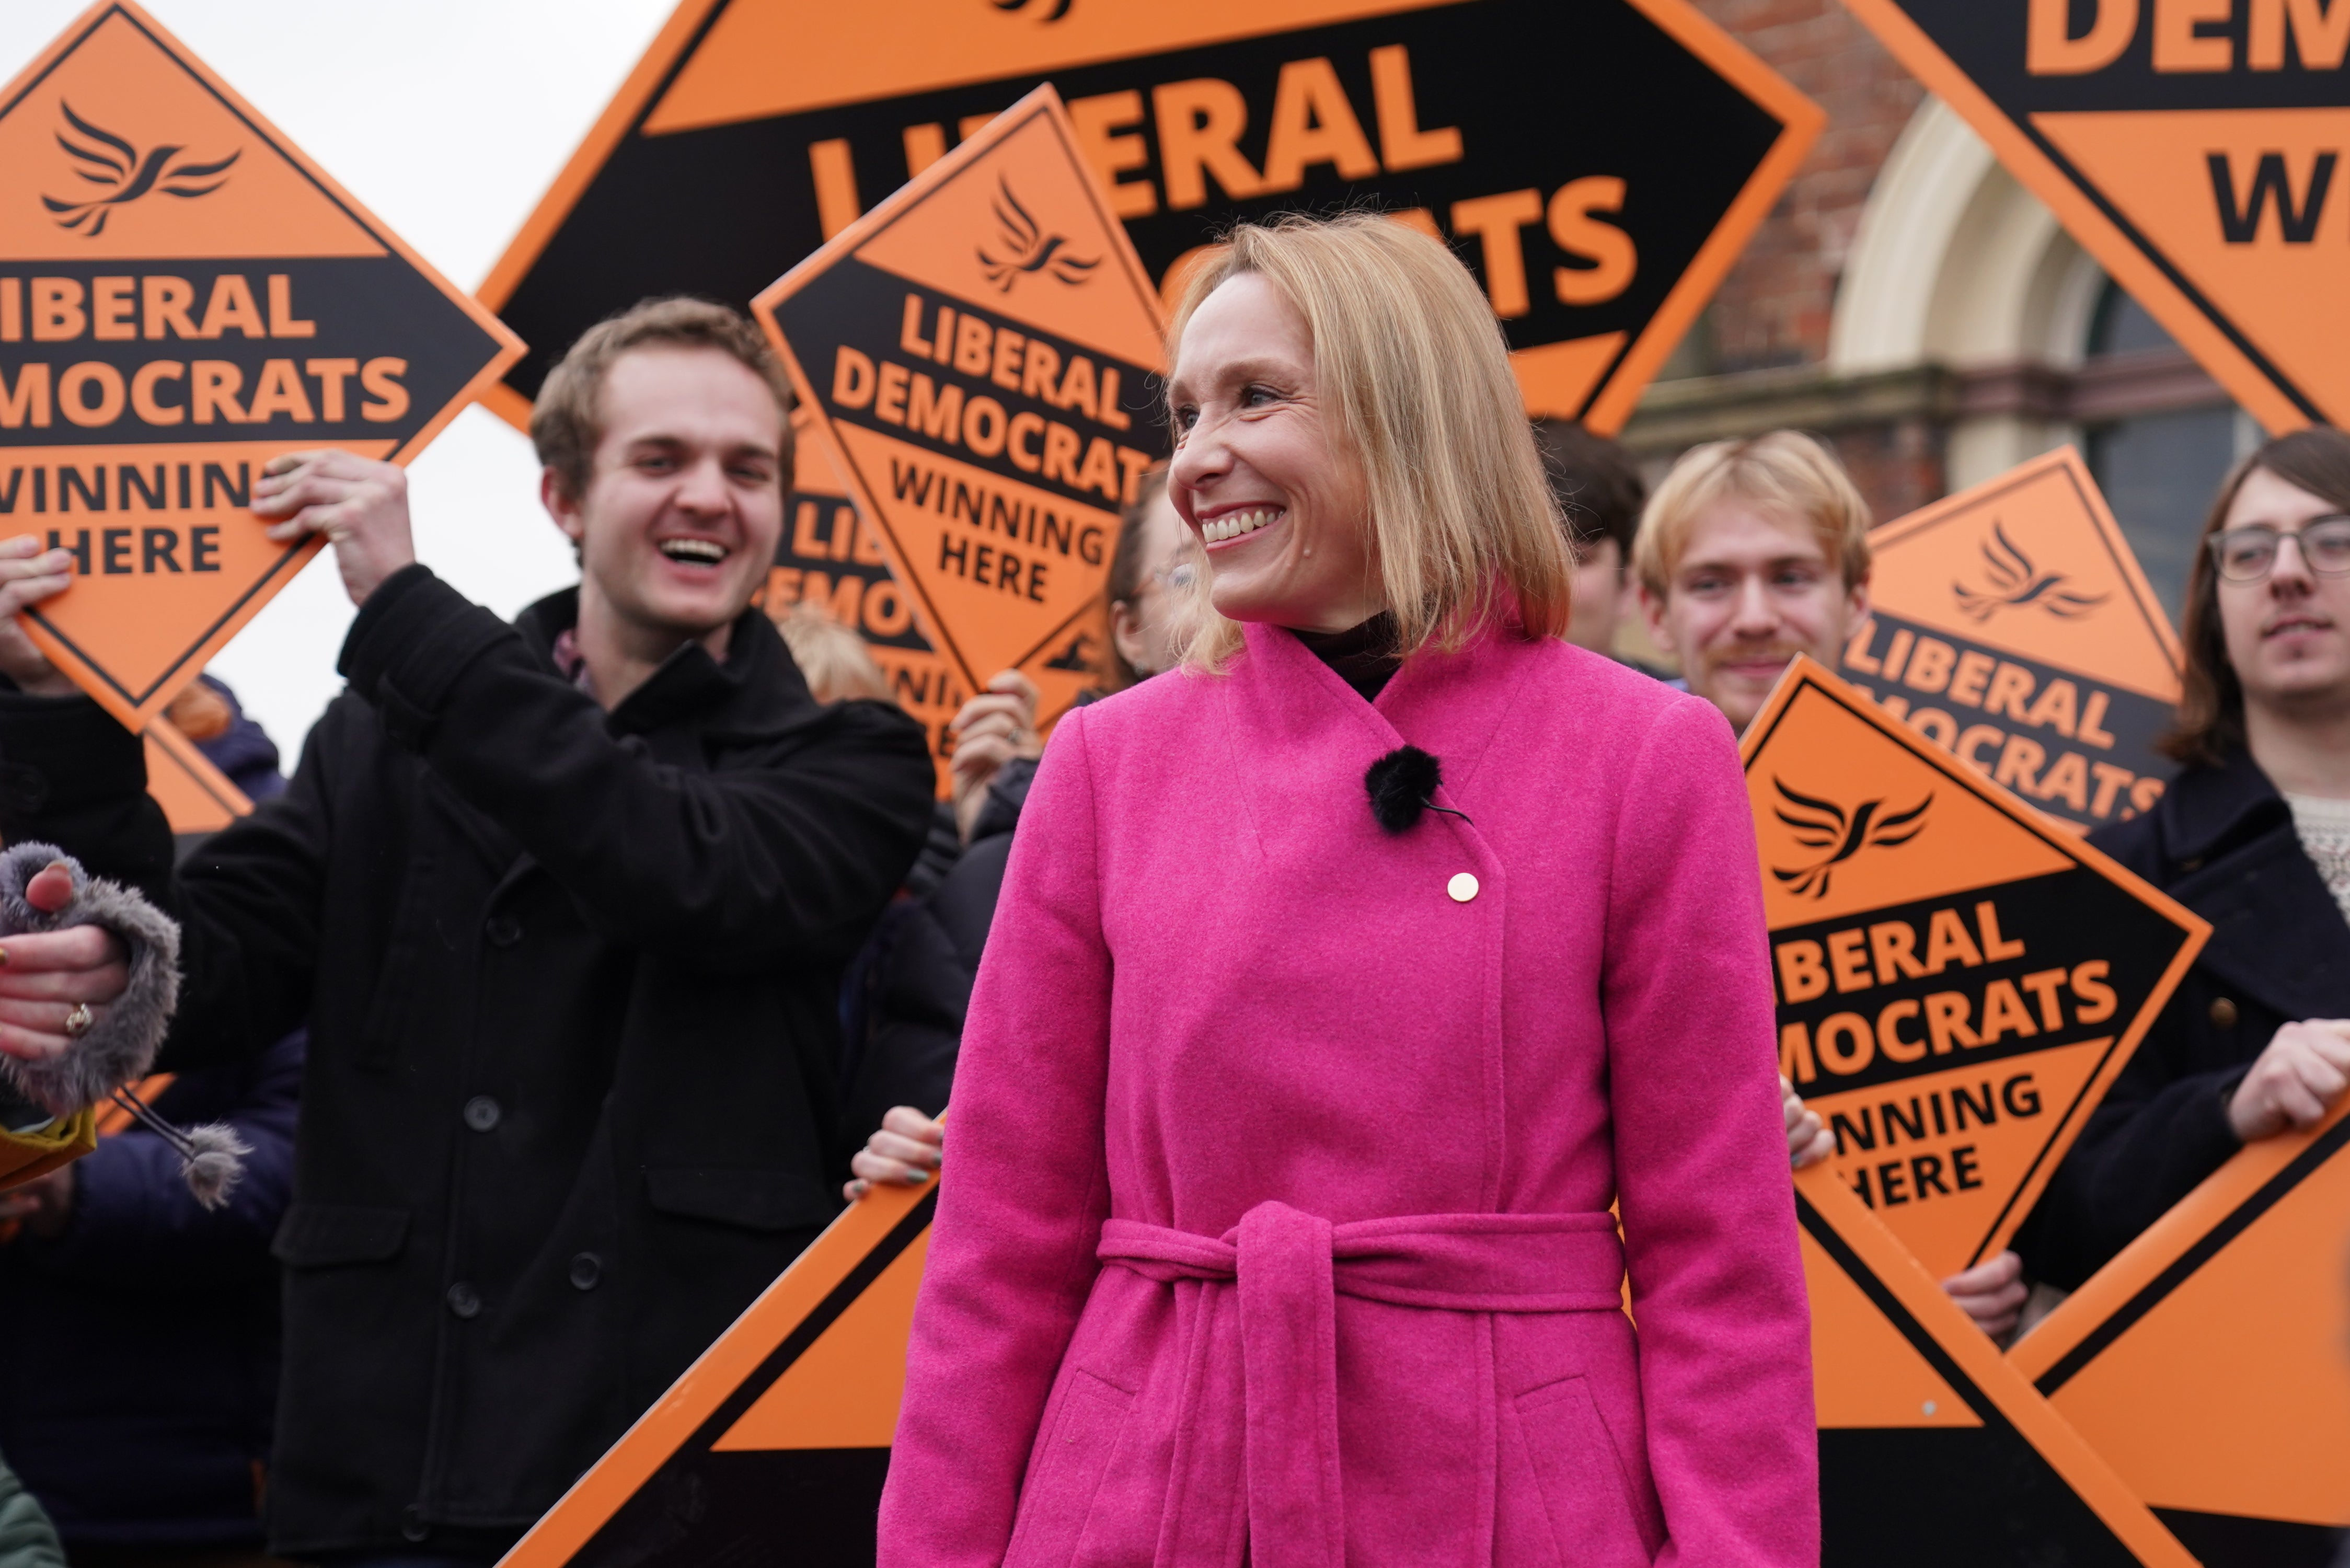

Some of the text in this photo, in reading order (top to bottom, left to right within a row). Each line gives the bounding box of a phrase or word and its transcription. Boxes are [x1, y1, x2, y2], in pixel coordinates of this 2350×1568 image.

[2205, 150, 2350, 245] W
[899, 293, 1131, 432] LIBERAL
[832, 344, 1171, 506] DEMOCRAT
[0, 460, 273, 514] INNIN
[890, 457, 1104, 567] WINNING
[46, 525, 221, 577] HERE
[939, 530, 1049, 603] HERE
[1843, 618, 2116, 751] LIBERAL
[1770, 900, 2026, 1006] BERAL
